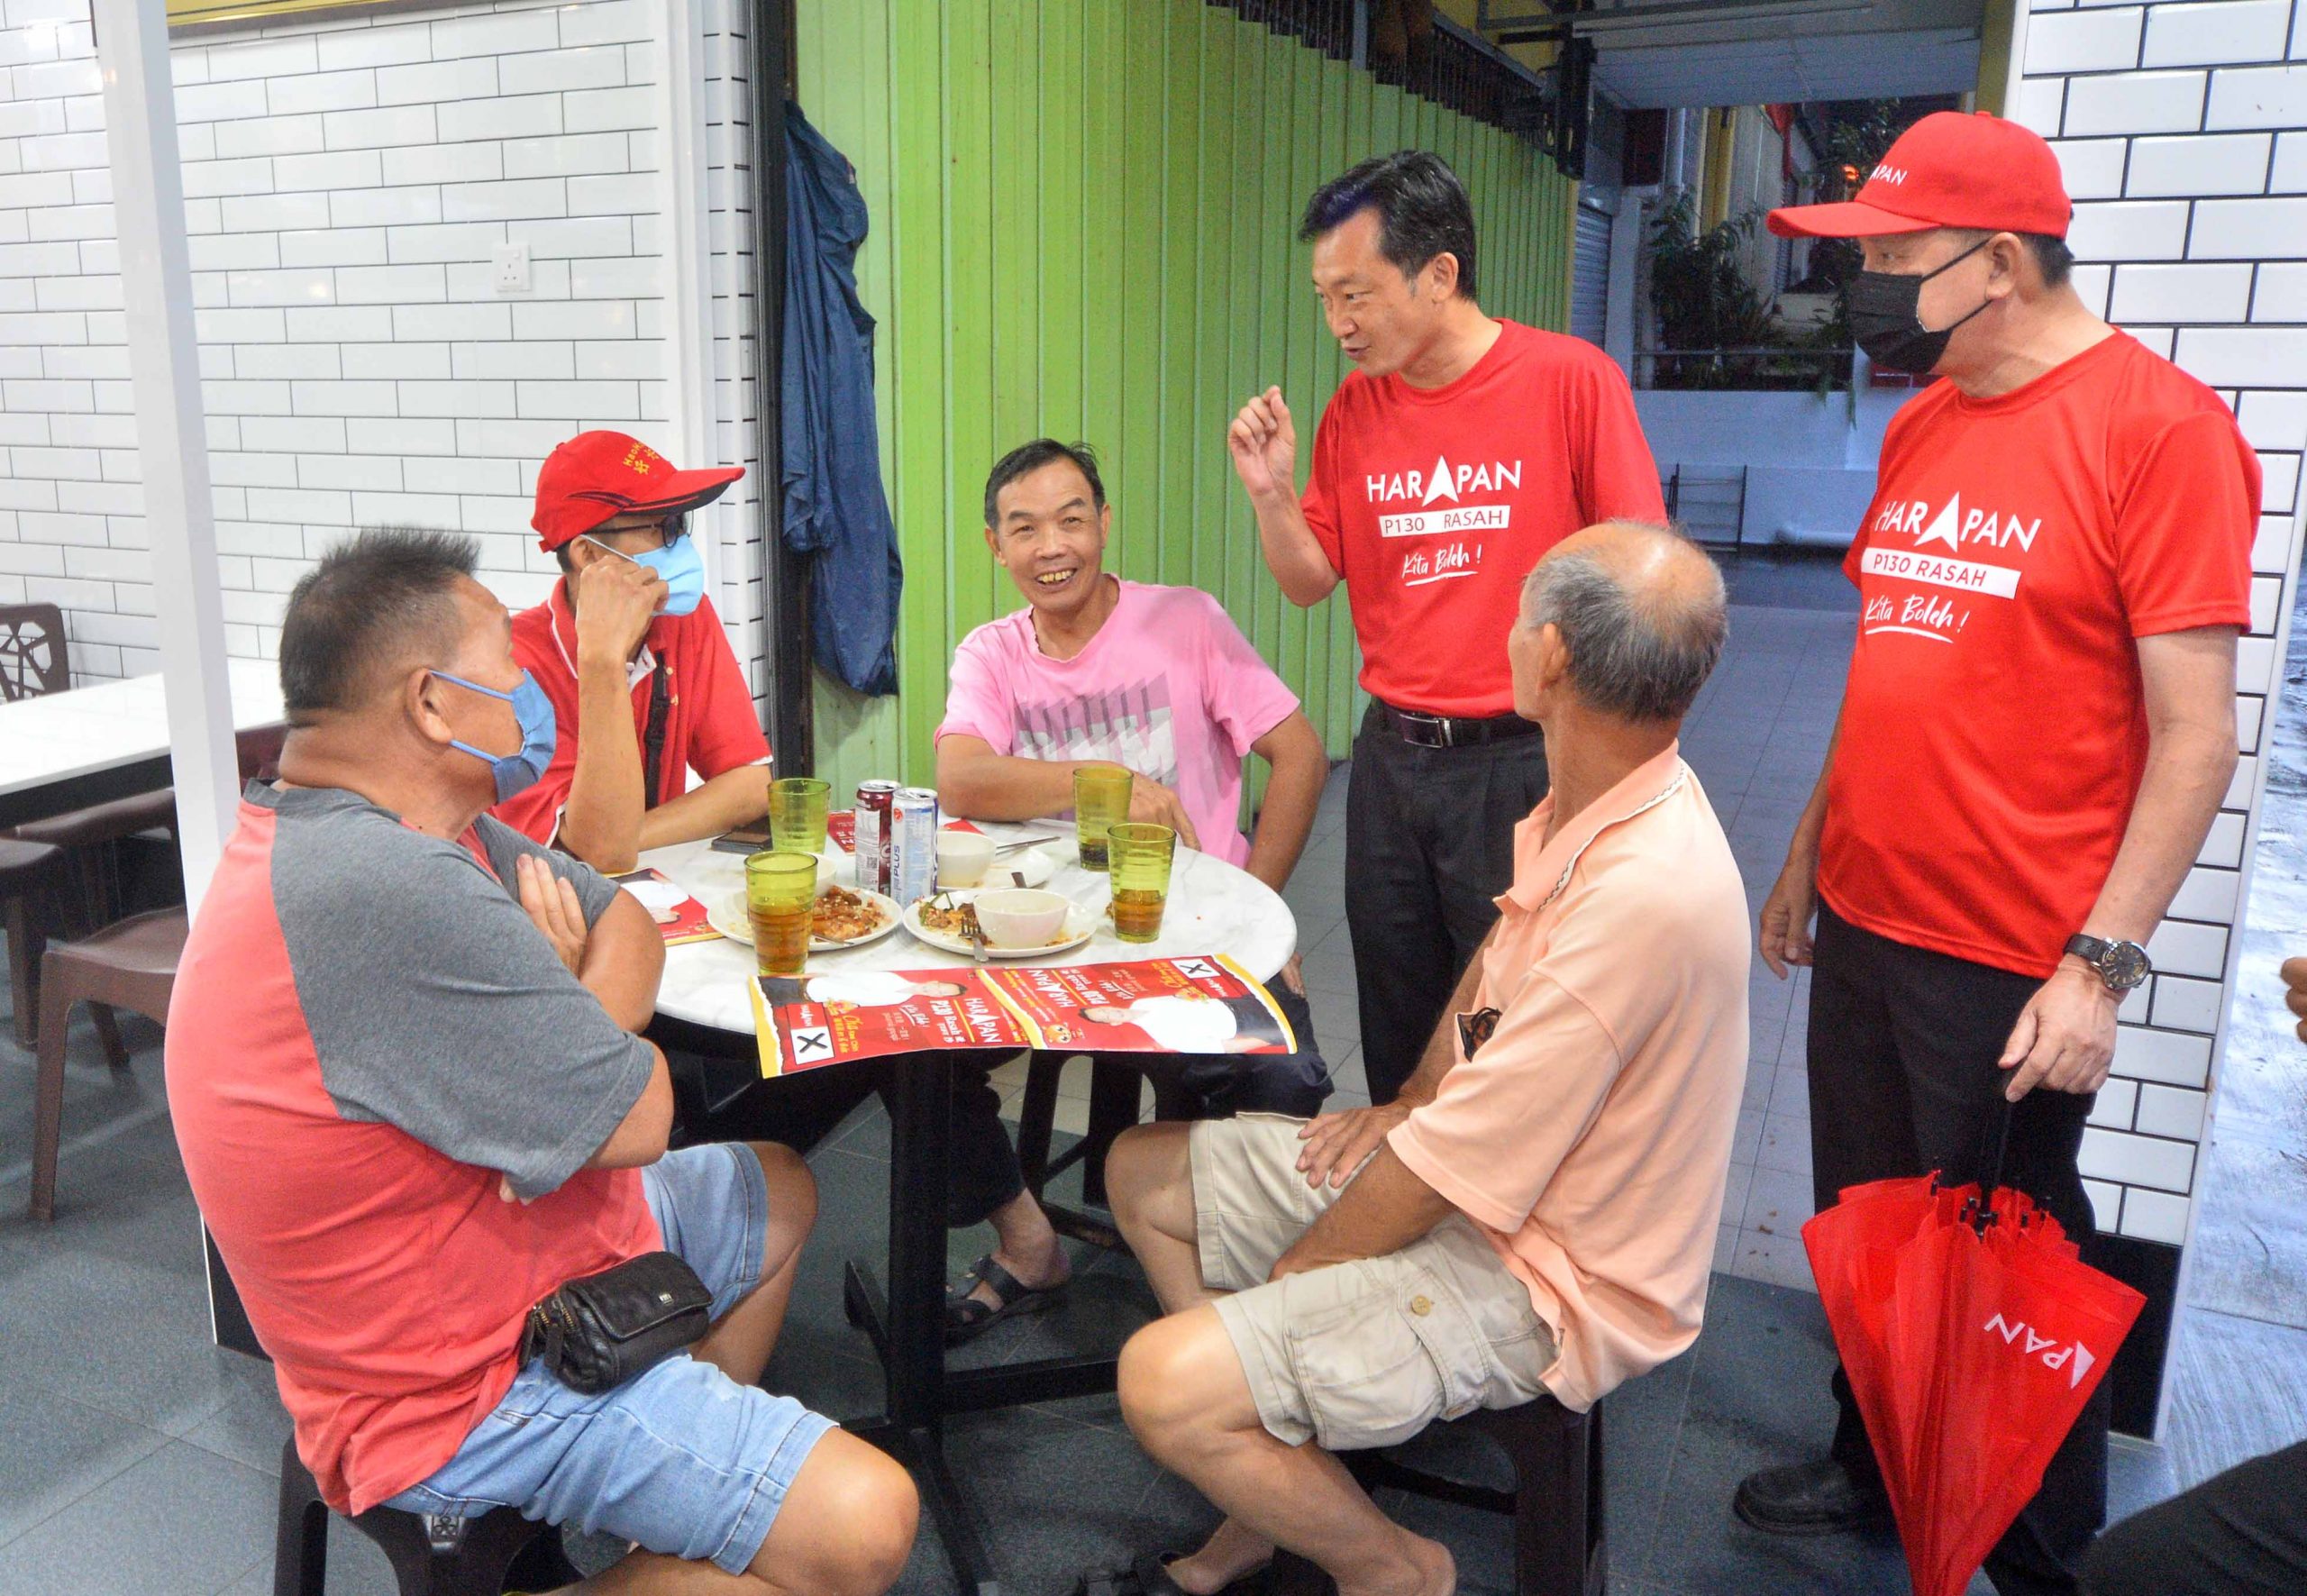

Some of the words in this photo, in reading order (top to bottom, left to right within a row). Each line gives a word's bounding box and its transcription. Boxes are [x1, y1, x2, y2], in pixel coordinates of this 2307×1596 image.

[1366, 455, 1522, 507] HARAPAN
[1384, 516, 1425, 534] P130
[1444, 509, 1503, 528] RASAH
[1874, 490, 2042, 553] HARAPAN
[1402, 552, 1428, 579] Kita
[1873, 553, 1911, 573] P130
[1916, 561, 1986, 587] RASAH
[1864, 595, 1893, 625] Kita
[964, 998, 1003, 1044] HARAPAN
